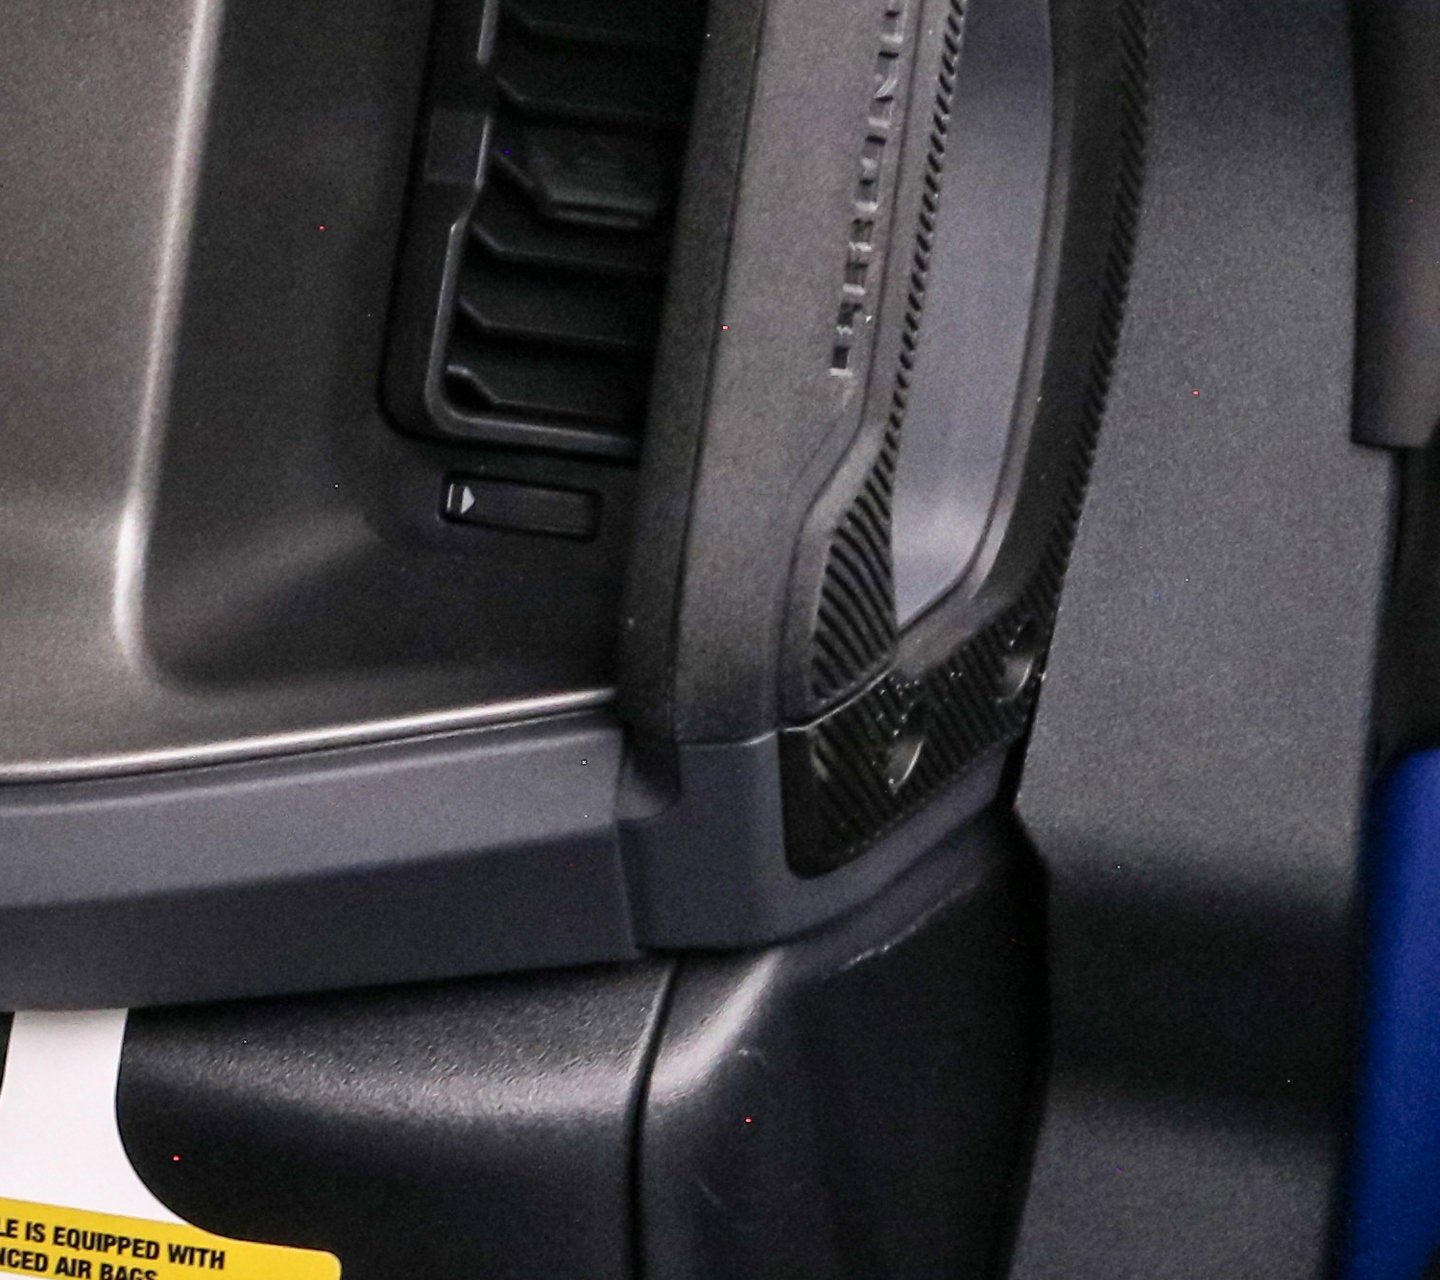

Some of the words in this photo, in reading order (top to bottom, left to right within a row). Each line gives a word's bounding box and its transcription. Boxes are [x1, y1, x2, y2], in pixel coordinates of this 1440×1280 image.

[25, 1221, 46, 1244] IS
[53, 1226, 161, 1261] EQUIPPED
[168, 1243, 226, 1271] WITH
[54, 1256, 92, 1280] AIR
